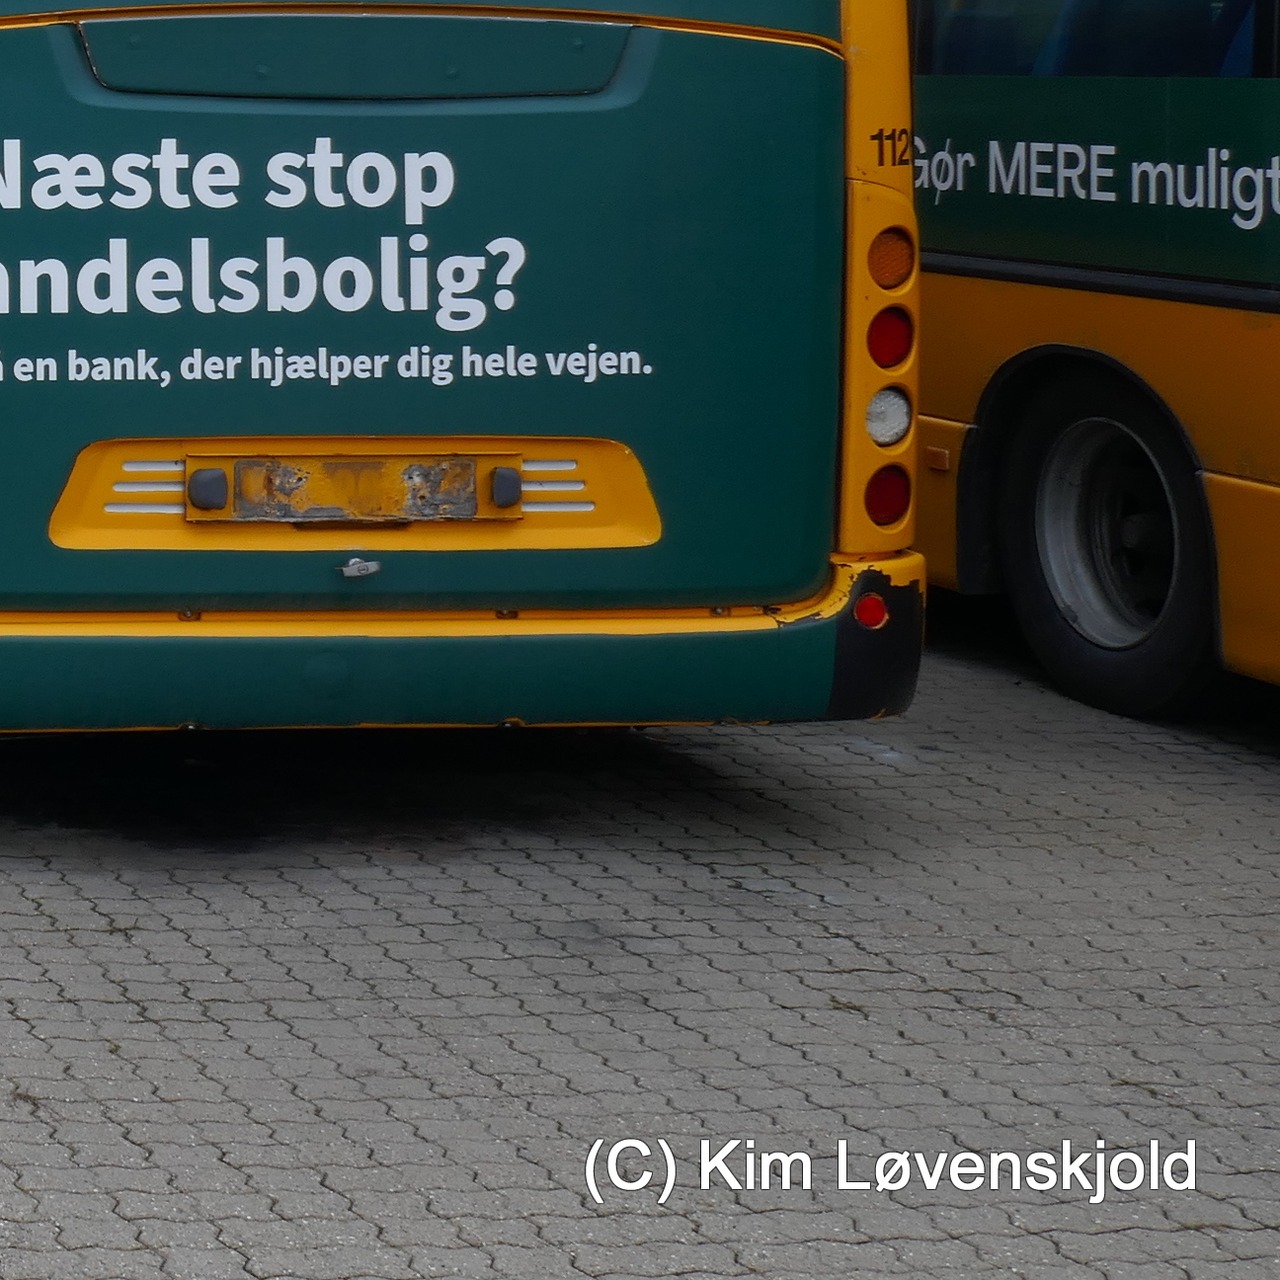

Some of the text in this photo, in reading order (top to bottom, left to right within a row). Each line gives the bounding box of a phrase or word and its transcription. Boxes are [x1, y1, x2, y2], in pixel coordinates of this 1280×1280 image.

[264, 137, 455, 225] stop
[988, 140, 1117, 202] MERE
[1131, 147, 1280, 230] muligt
[12, 358, 58, 381] en
[67, 350, 172, 389] bank,
[179, 349, 242, 381] der
[249, 347, 390, 388] hjælper
[396, 345, 454, 387] dig
[461, 346, 537, 378] hele
[545, 344, 652, 382] vejen.
